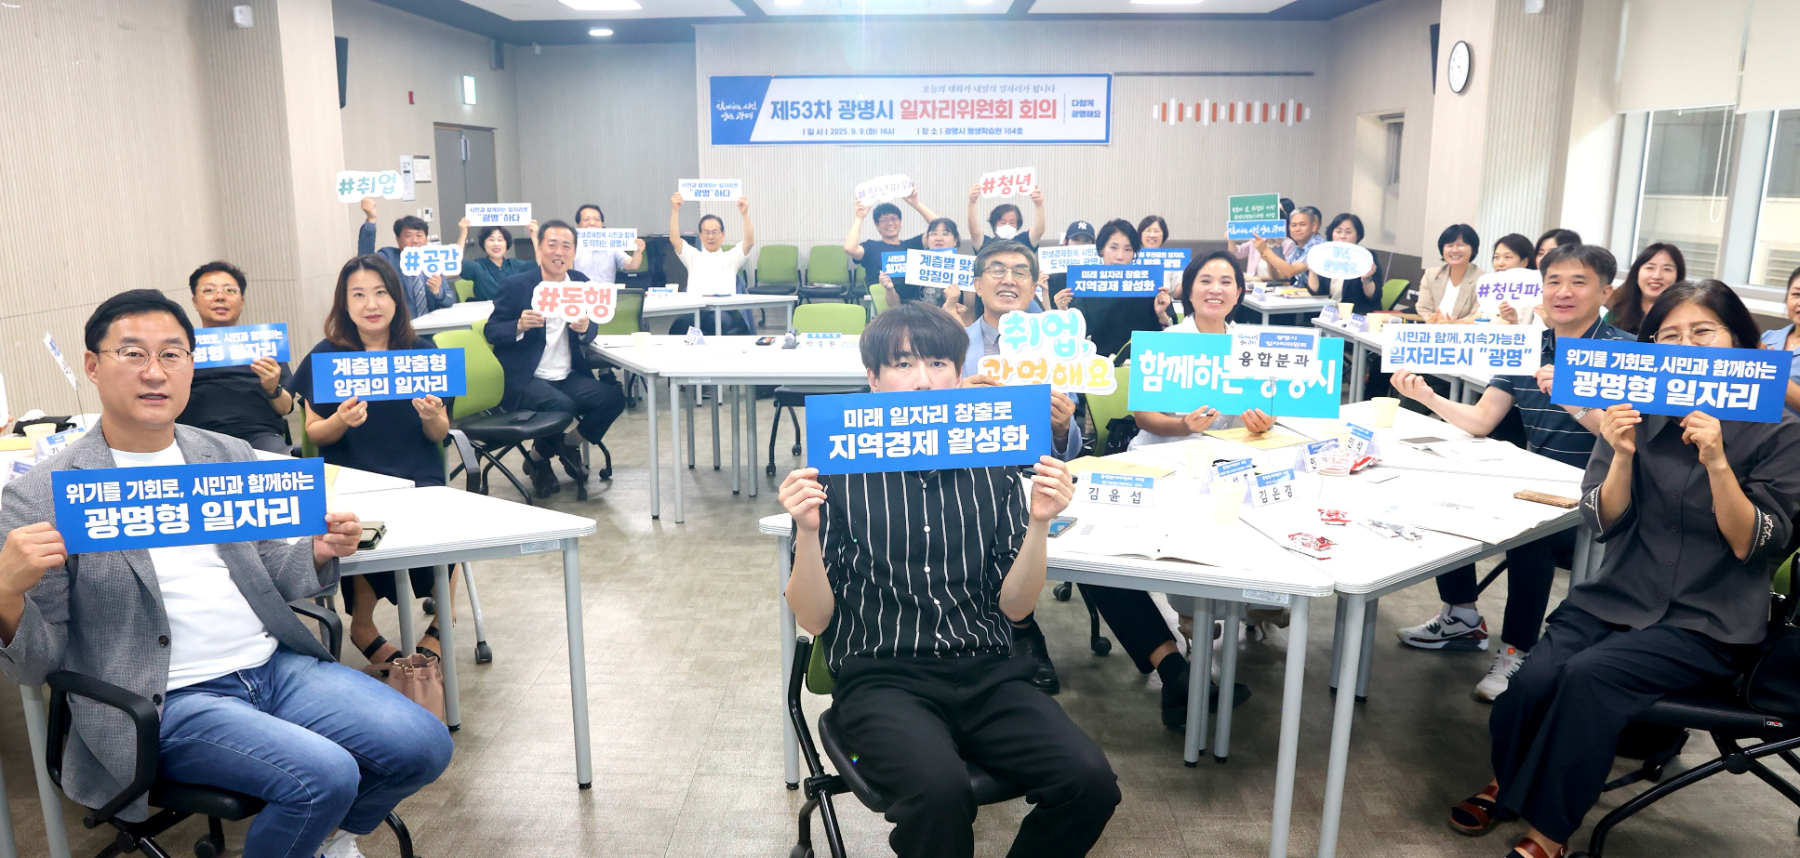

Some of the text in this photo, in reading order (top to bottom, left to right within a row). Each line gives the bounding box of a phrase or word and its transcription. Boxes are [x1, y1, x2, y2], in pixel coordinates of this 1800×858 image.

[923, 85, 945, 94] 오늘의
[1000, 85, 1030, 94] 일자리가
[1033, 85, 1056, 94] 됩니다
[771, 99, 1056, 120] 제53차 광명시 일자리위원회 회의
[1072, 99, 1094, 107] 다함께
[1072, 110, 1101, 118] 광명해요
[338, 173, 396, 195] #취업
[982, 172, 1032, 195] #청년
[405, 249, 459, 273] #공감
[920, 254, 955, 270] 계층별
[919, 269, 954, 284] 양질의
[1081, 270, 1149, 279] 미래 일자리 창출로
[1075, 280, 1155, 292] 지역경제 활성화
[1478, 282, 1543, 301] #청년파
[537, 287, 611, 318] #동행
[1003, 311, 1089, 357] 취업,
[1394, 331, 1526, 346] 시민과 함께, 지속가능한
[229, 341, 277, 360] 일자리
[1389, 346, 1473, 366] 일자리도시
[332, 354, 447, 376] 계층별 맞춤형
[983, 358, 1111, 387] 광명해요
[1139, 349, 1243, 394] 함께하는
[1566, 349, 1778, 380] 위기를 기회로, 시민과 함께하는
[334, 374, 448, 397] 양질의 일자리
[1572, 370, 1760, 411] 광명형 일자리
[843, 401, 1012, 429] 미래 일자리 창출로
[829, 424, 1029, 460] 지역경제 활성화
[66, 471, 314, 504] 위기를 기회로, 시민과 함께하는
[84, 496, 300, 539] 광명형 일자리
